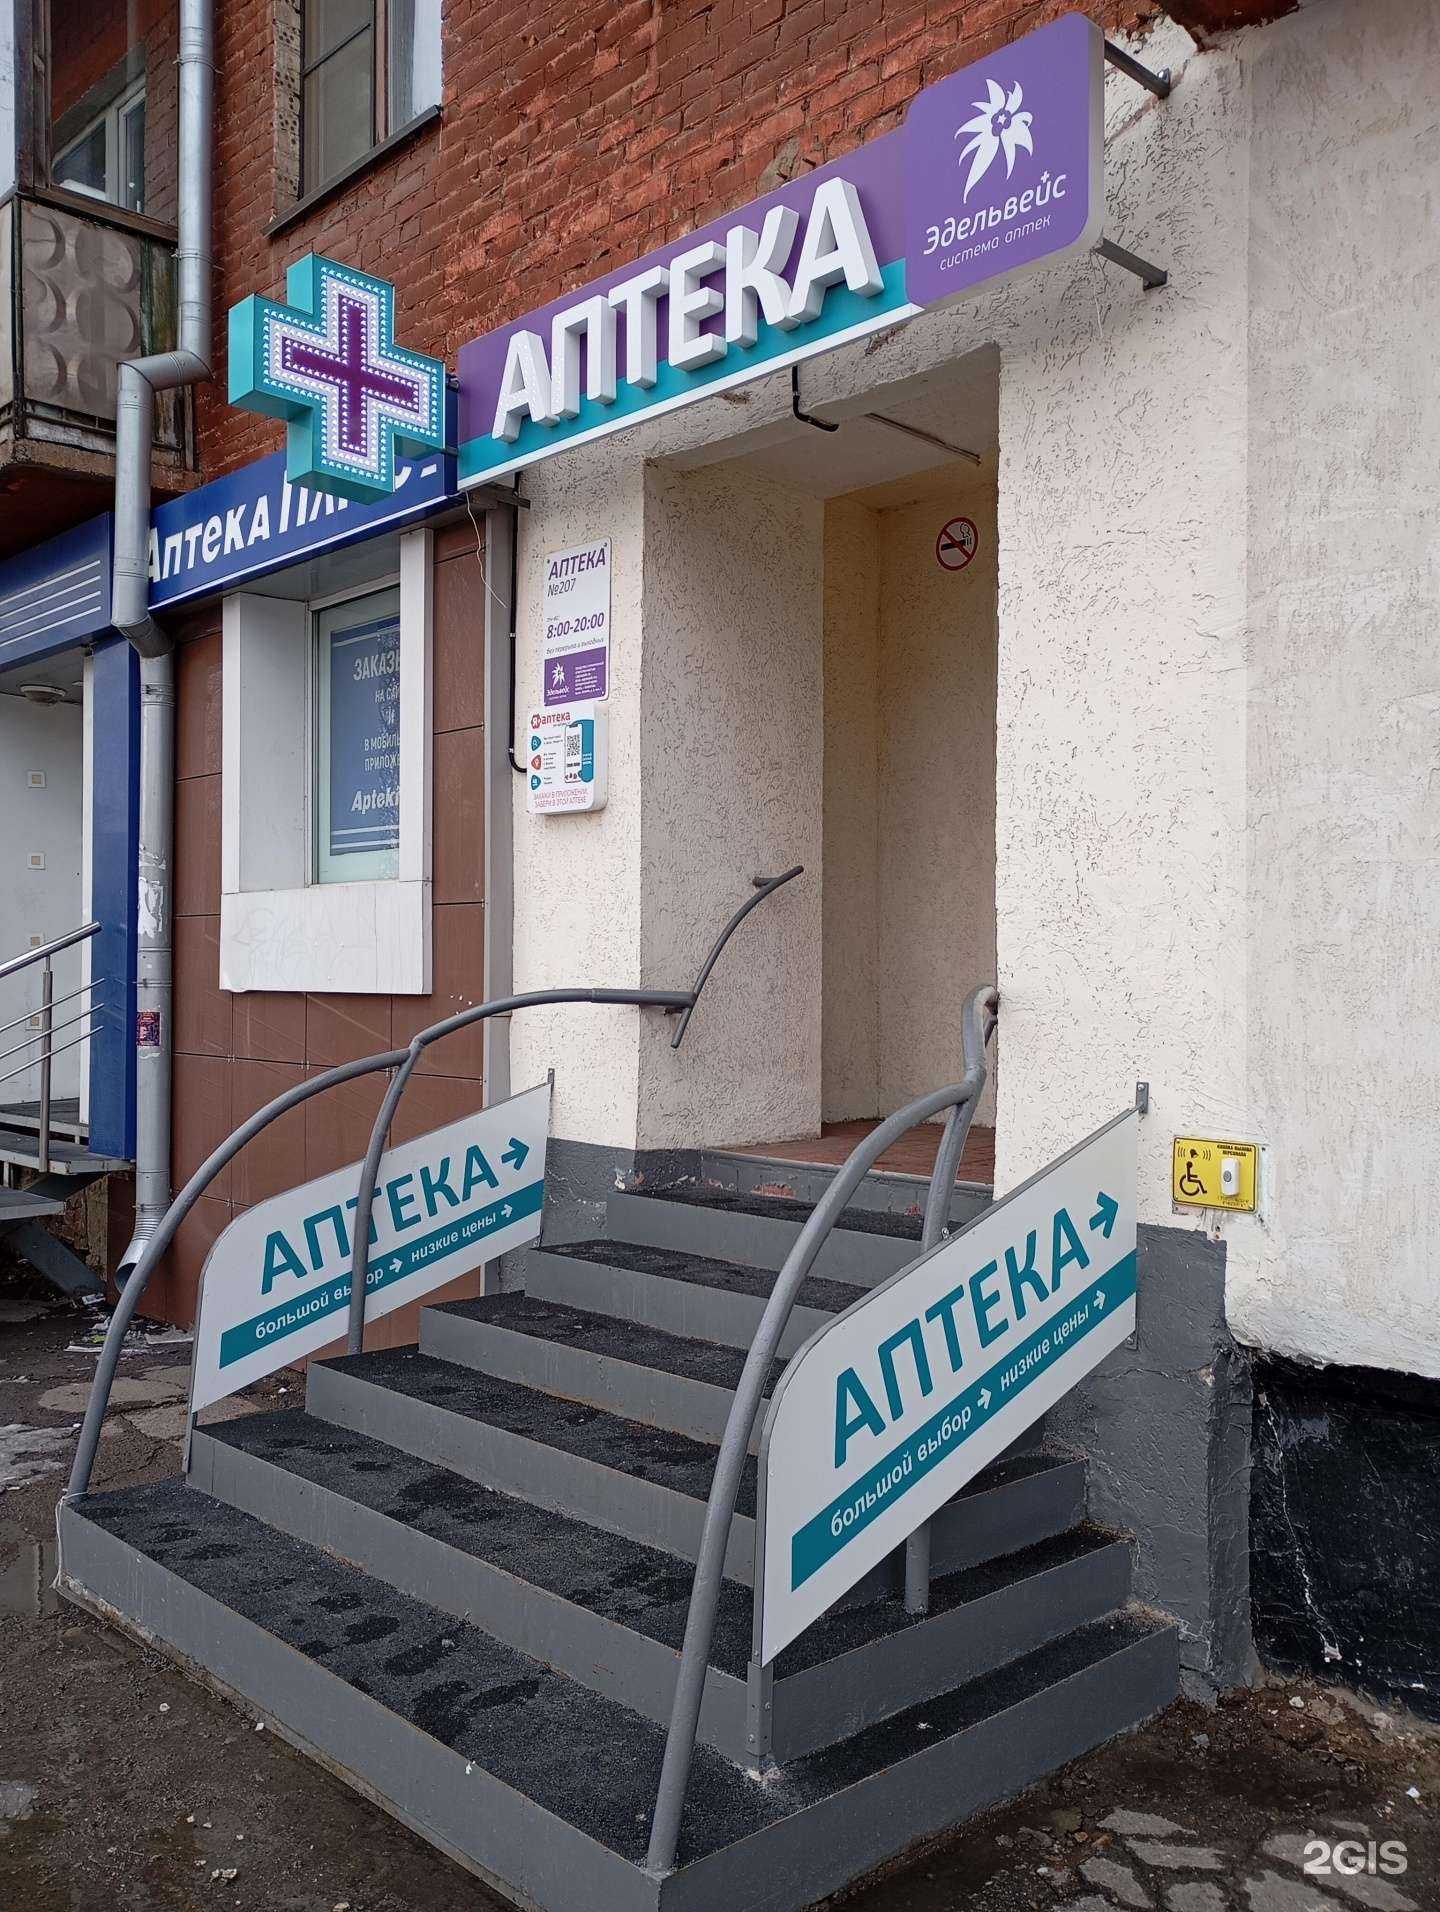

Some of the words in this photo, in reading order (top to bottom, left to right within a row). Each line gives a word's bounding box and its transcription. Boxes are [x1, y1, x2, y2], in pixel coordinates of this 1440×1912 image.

[923, 169, 1067, 255] Эдельвейс
[939, 236, 999, 271] система
[1004, 214, 1051, 244] аптек
[491, 176, 885, 443] АПТЕКА
[547, 547, 606, 581] АПТЕКА
[547, 577, 577, 597] №207
[546, 612, 605, 640] 8:00-20:00
[364, 738, 370, 751] В
[255, 1288, 329, 1340] большой
[411, 1230, 459, 1263] низкие
[462, 1210, 497, 1239] цены
[834, 1207, 1090, 1469] АПТЕКА
[830, 1449, 913, 1537] большой
[917, 1405, 972, 1462] выбор
[1000, 1338, 1051, 1392] низкие
[1053, 1304, 1090, 1347] цены
